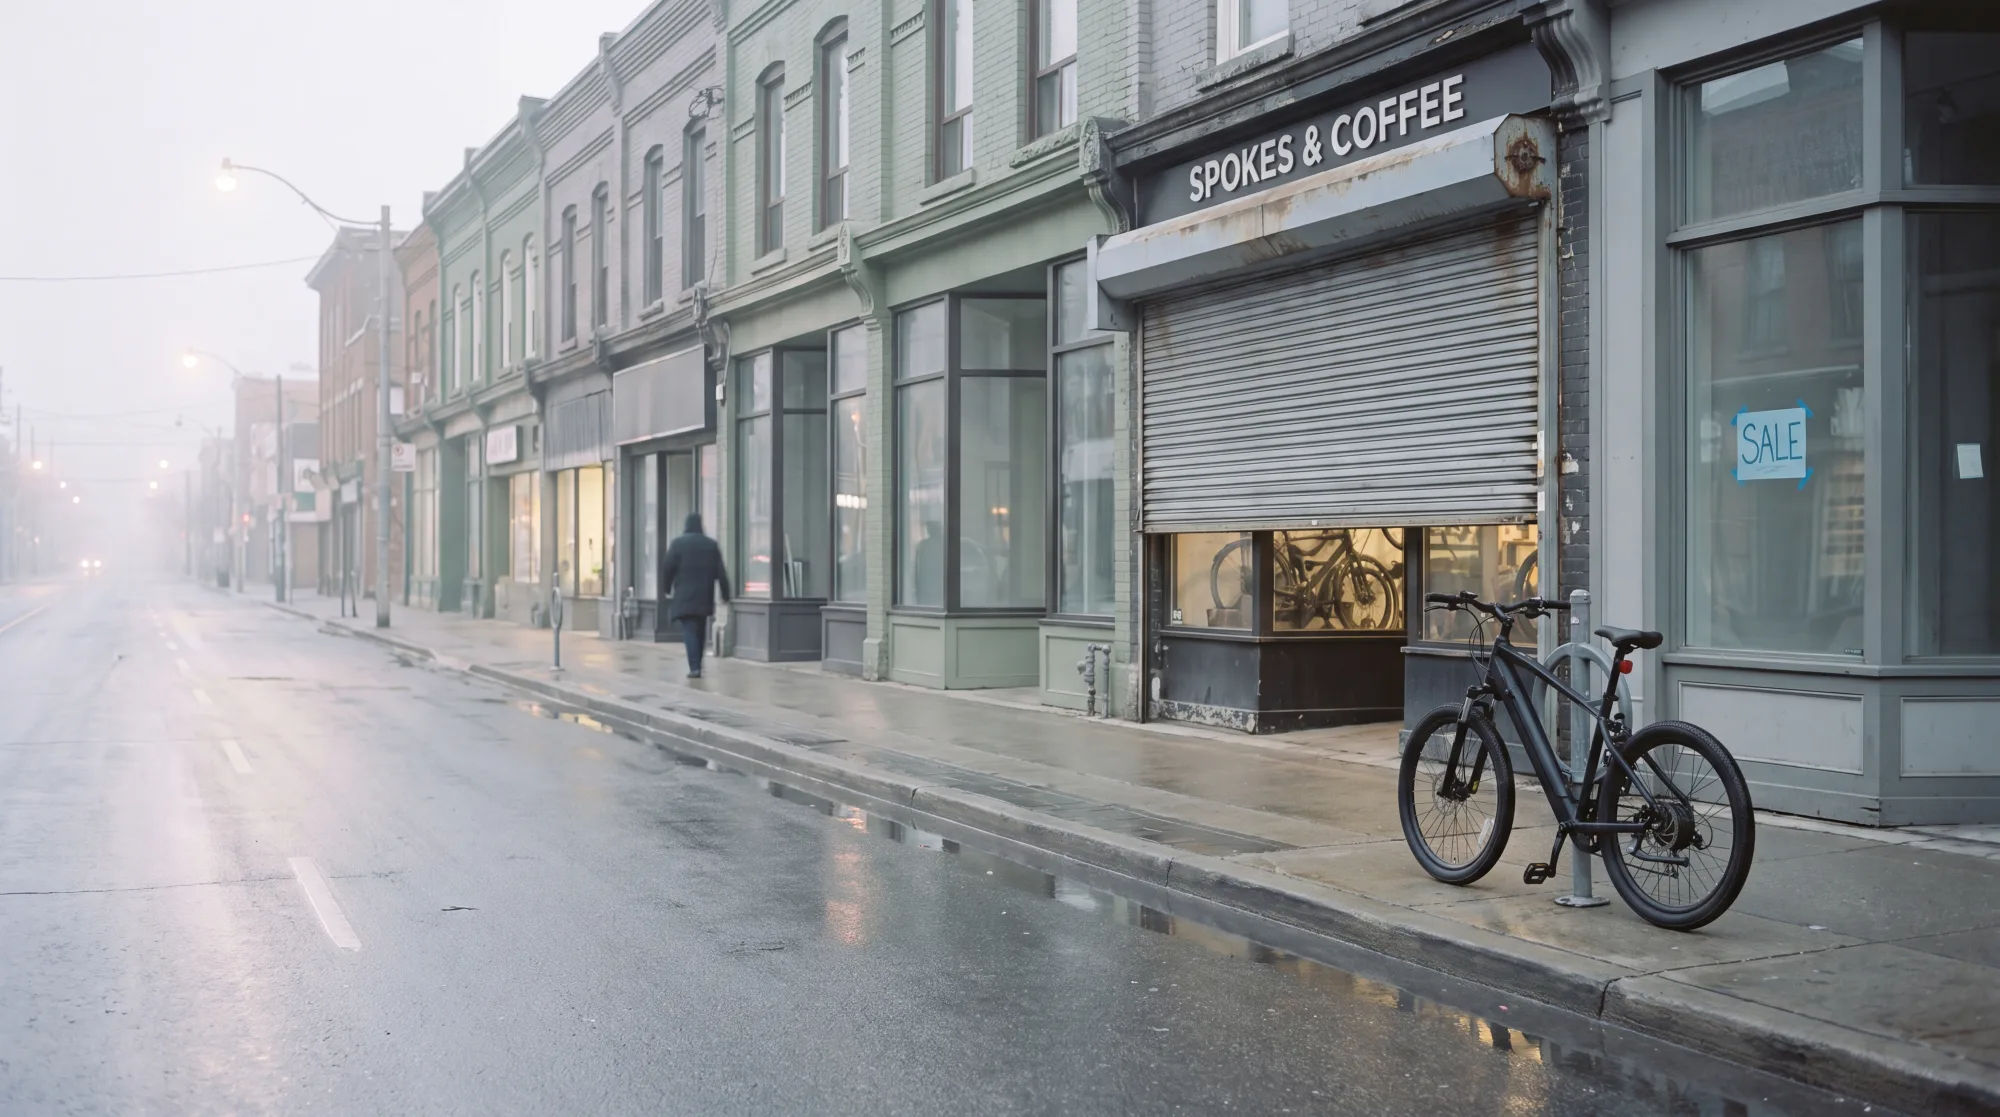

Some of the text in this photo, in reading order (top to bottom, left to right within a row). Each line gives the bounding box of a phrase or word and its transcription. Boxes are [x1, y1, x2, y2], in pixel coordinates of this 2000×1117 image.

[1189, 73, 1464, 202] SPOKES & COFFEE
[1741, 421, 1803, 465] SALE
